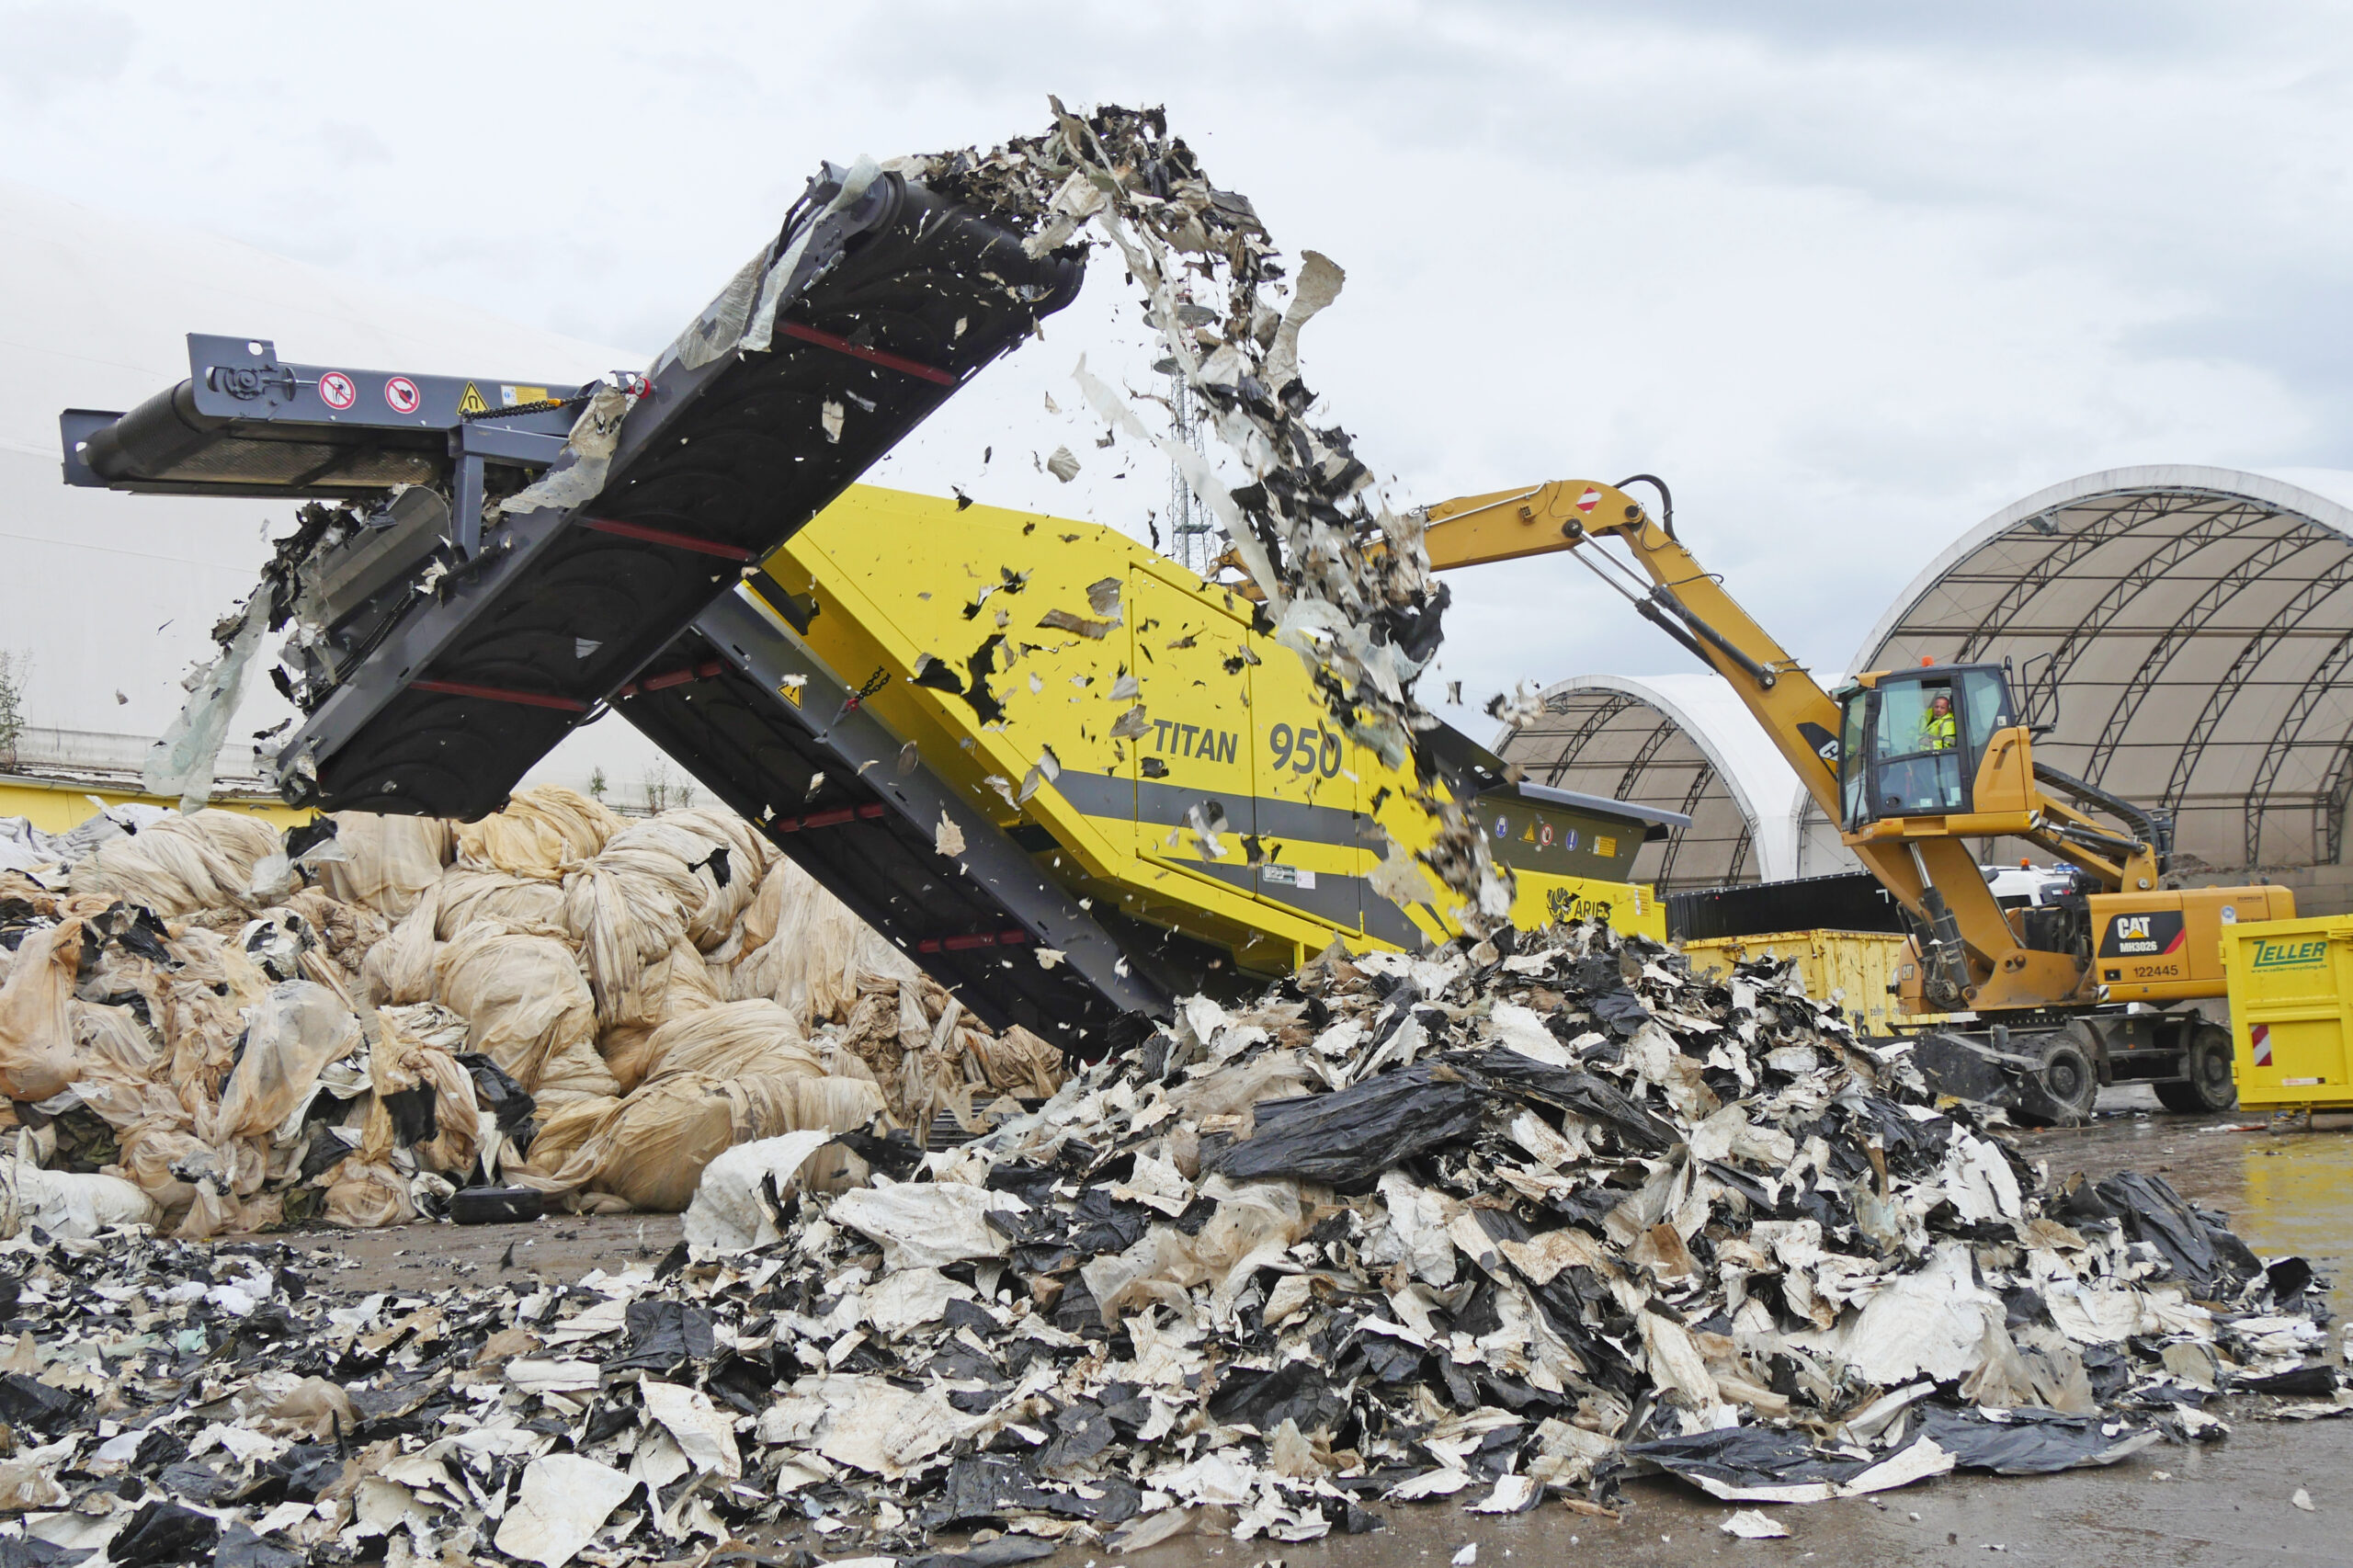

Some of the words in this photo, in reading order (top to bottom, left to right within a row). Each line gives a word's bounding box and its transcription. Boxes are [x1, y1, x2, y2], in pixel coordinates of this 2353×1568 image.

[1154, 719, 1238, 764] TITAN
[1269, 722, 1342, 778] 950
[2117, 916, 2150, 939] CAT
[2120, 941, 2157, 952] MH3026
[2253, 940, 2327, 967] ZELLER
[2133, 965, 2178, 977] 122445
